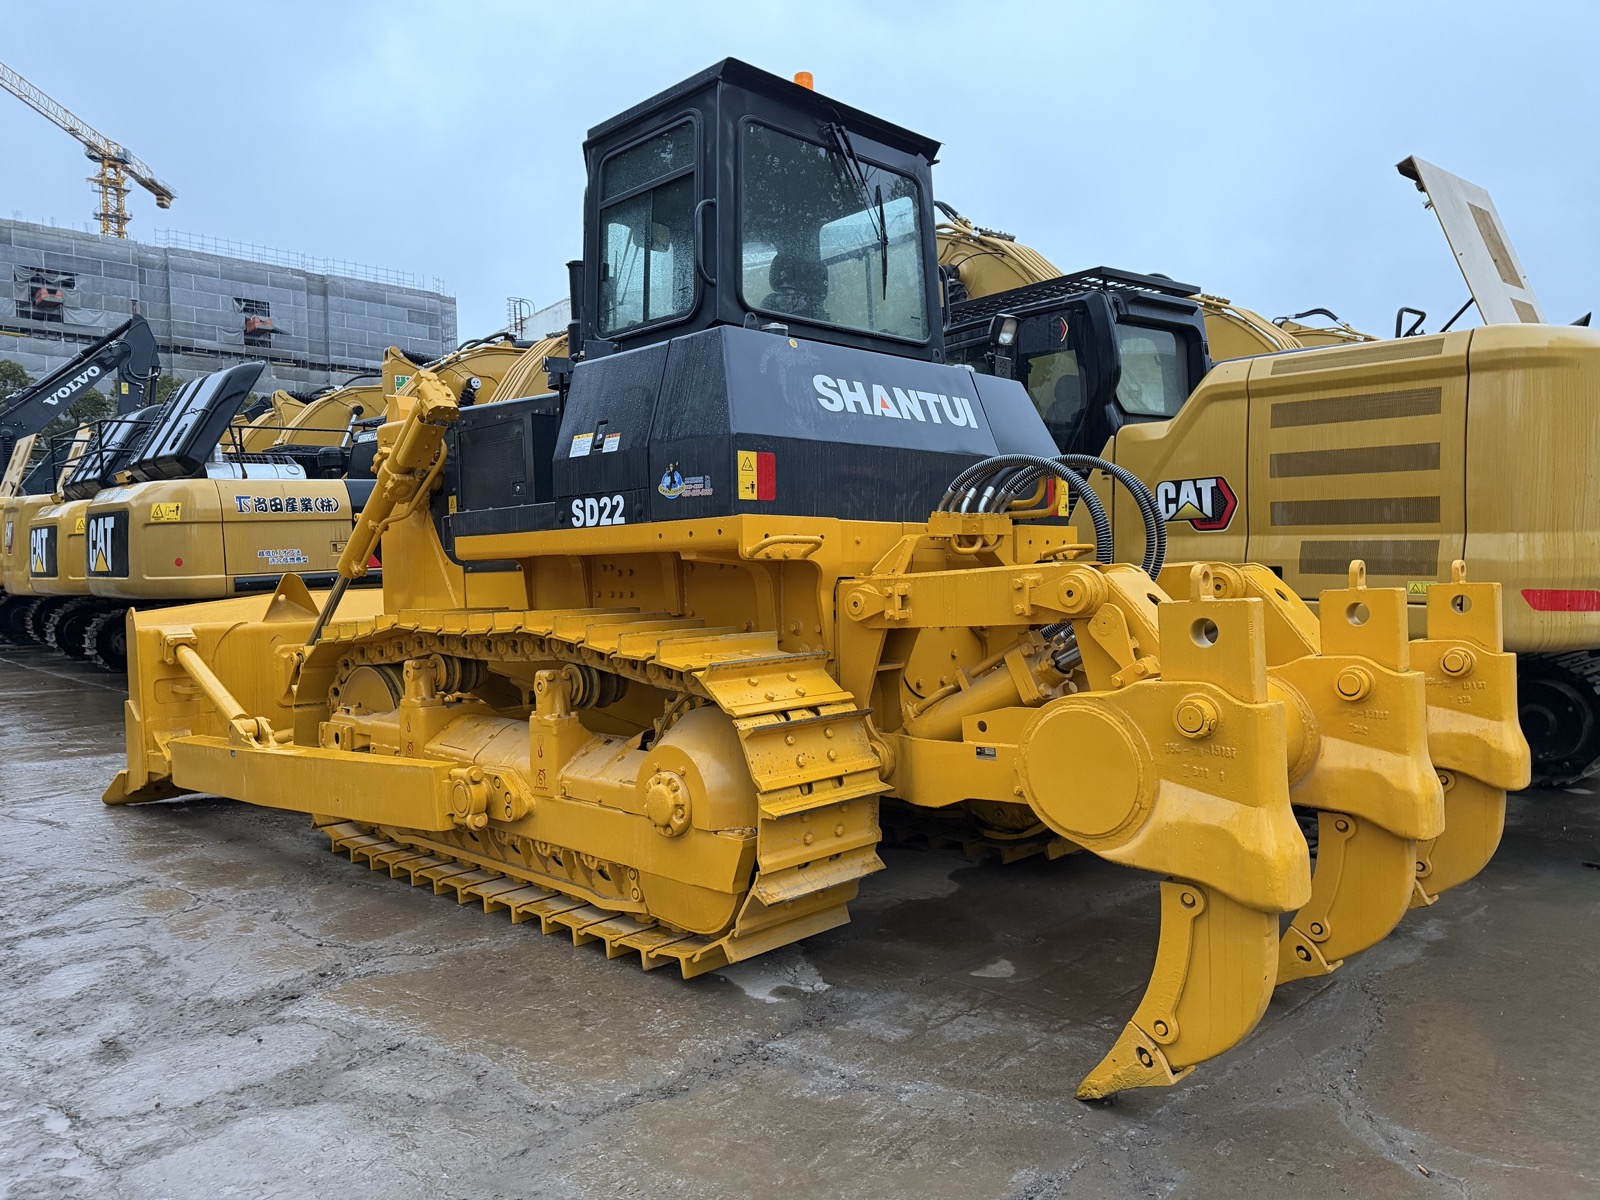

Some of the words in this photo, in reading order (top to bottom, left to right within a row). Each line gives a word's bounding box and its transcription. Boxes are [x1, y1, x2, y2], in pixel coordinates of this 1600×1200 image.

[43, 366, 100, 405] VOLVO
[812, 374, 979, 429] SHANTUI
[571, 494, 625, 527] SD22
[1157, 479, 1216, 520] CAT
[31, 528, 48, 573] CAT
[88, 517, 115, 572] CAT
